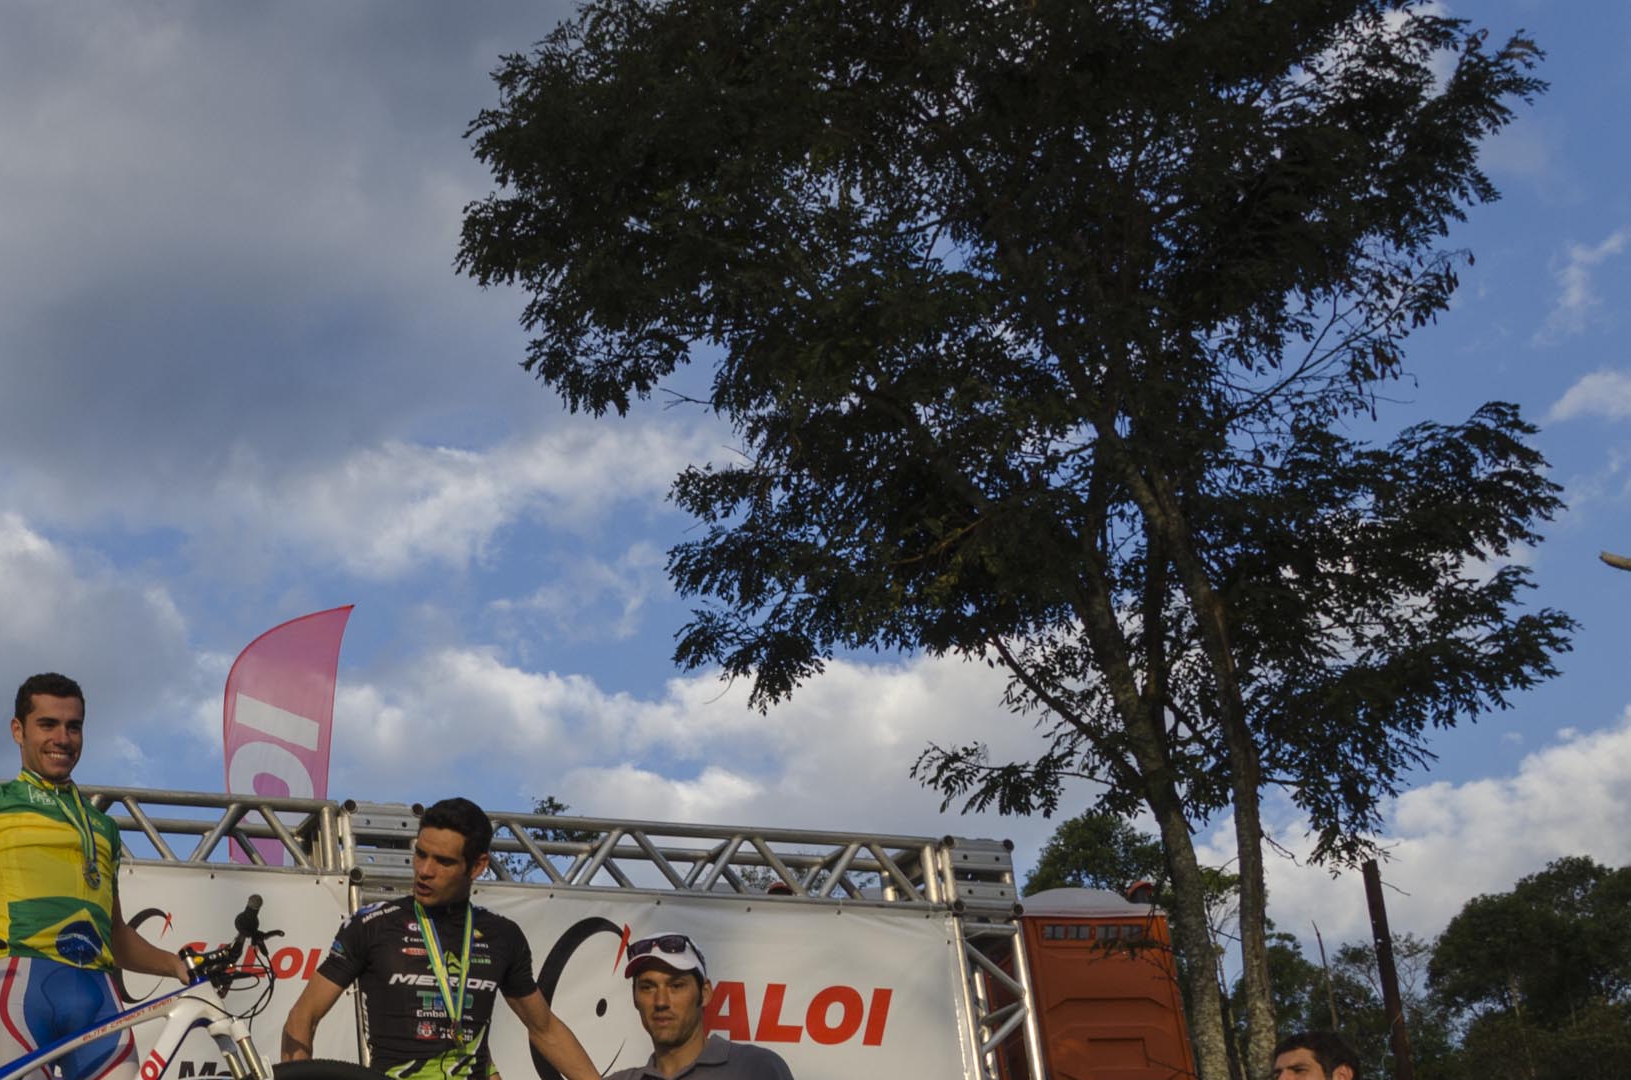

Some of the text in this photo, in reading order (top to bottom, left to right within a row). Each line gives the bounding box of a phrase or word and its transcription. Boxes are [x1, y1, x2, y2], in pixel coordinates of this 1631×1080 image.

[179, 941, 322, 981] LOI
[388, 973, 498, 992] MERDA
[702, 980, 893, 1047] ALOI
